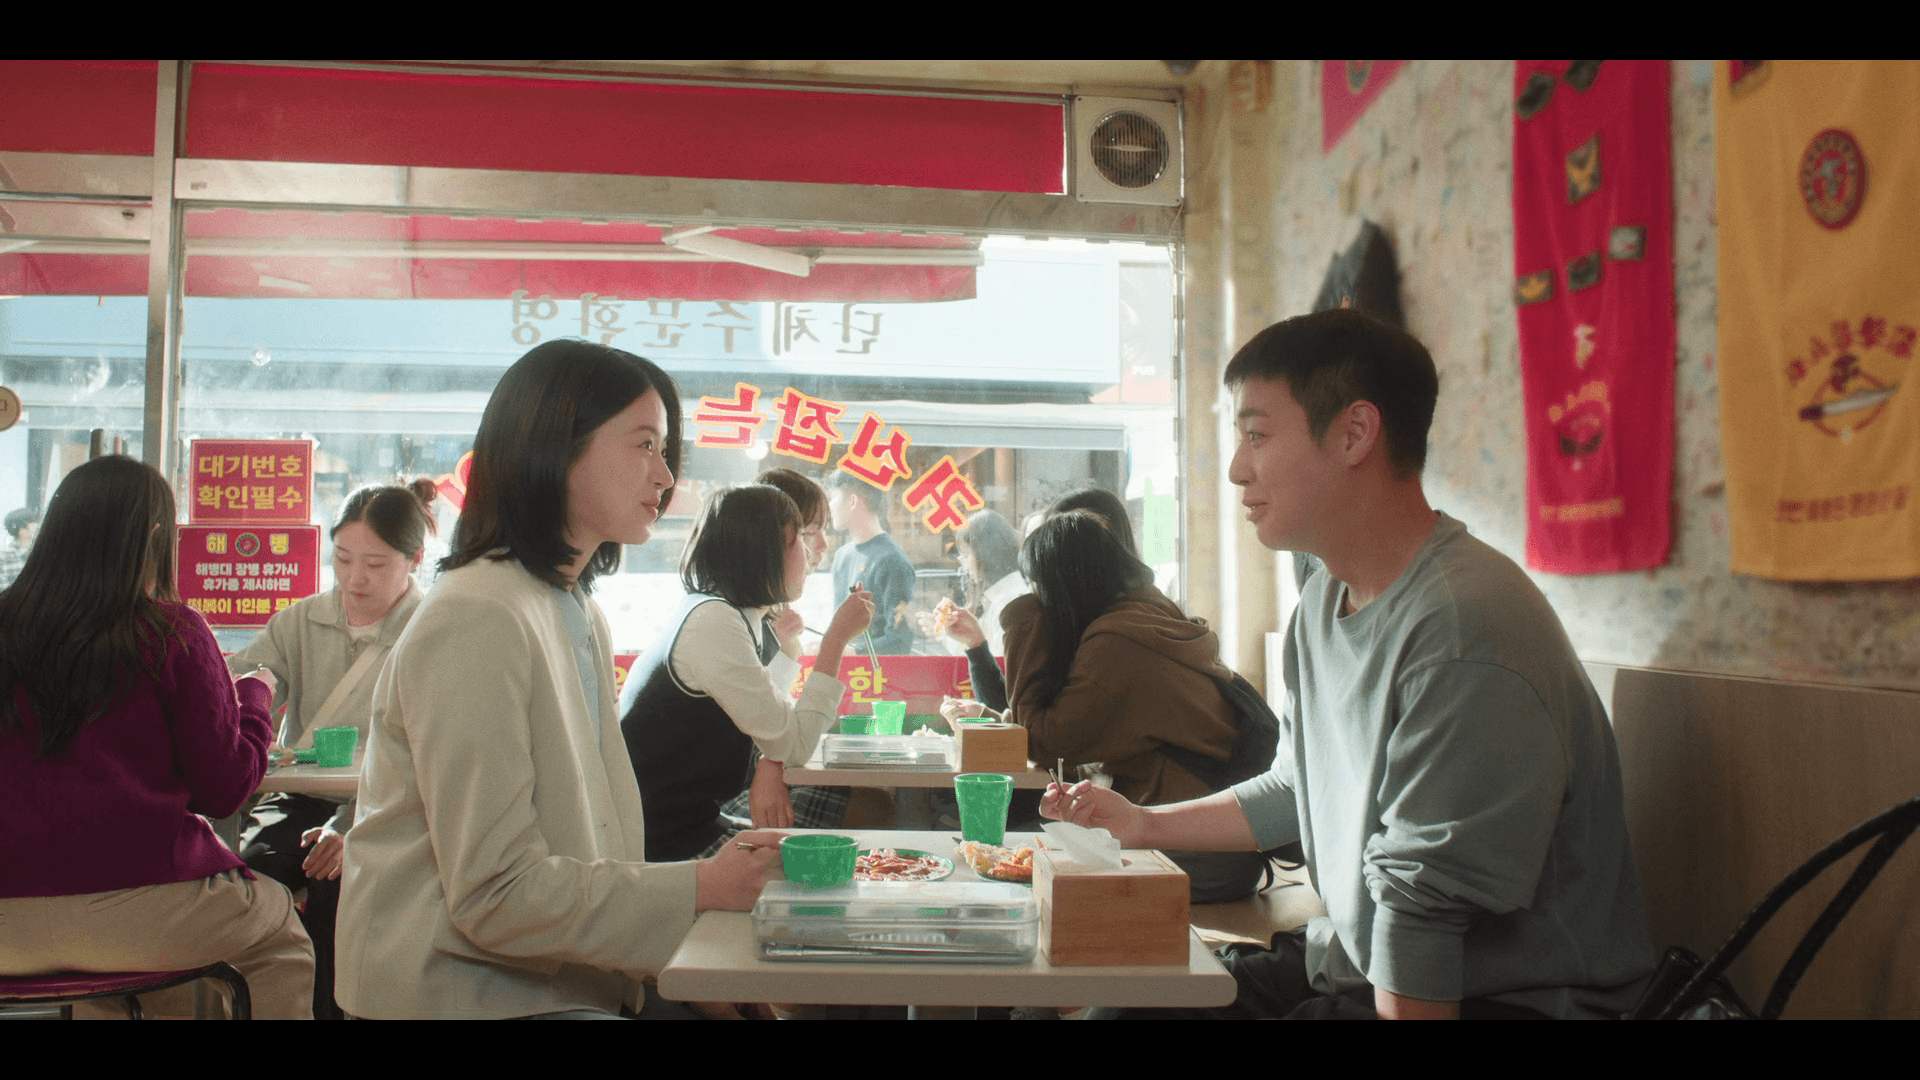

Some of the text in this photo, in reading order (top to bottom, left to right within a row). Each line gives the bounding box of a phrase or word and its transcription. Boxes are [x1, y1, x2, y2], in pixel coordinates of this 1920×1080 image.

[198, 455, 304, 479] 대기번호
[197, 484, 303, 510] 확인필수
[195, 562, 299, 577] 해병대 장병 휴가시
[242, 577, 291, 592] 제시하면
[236, 597, 271, 614] 1인분
